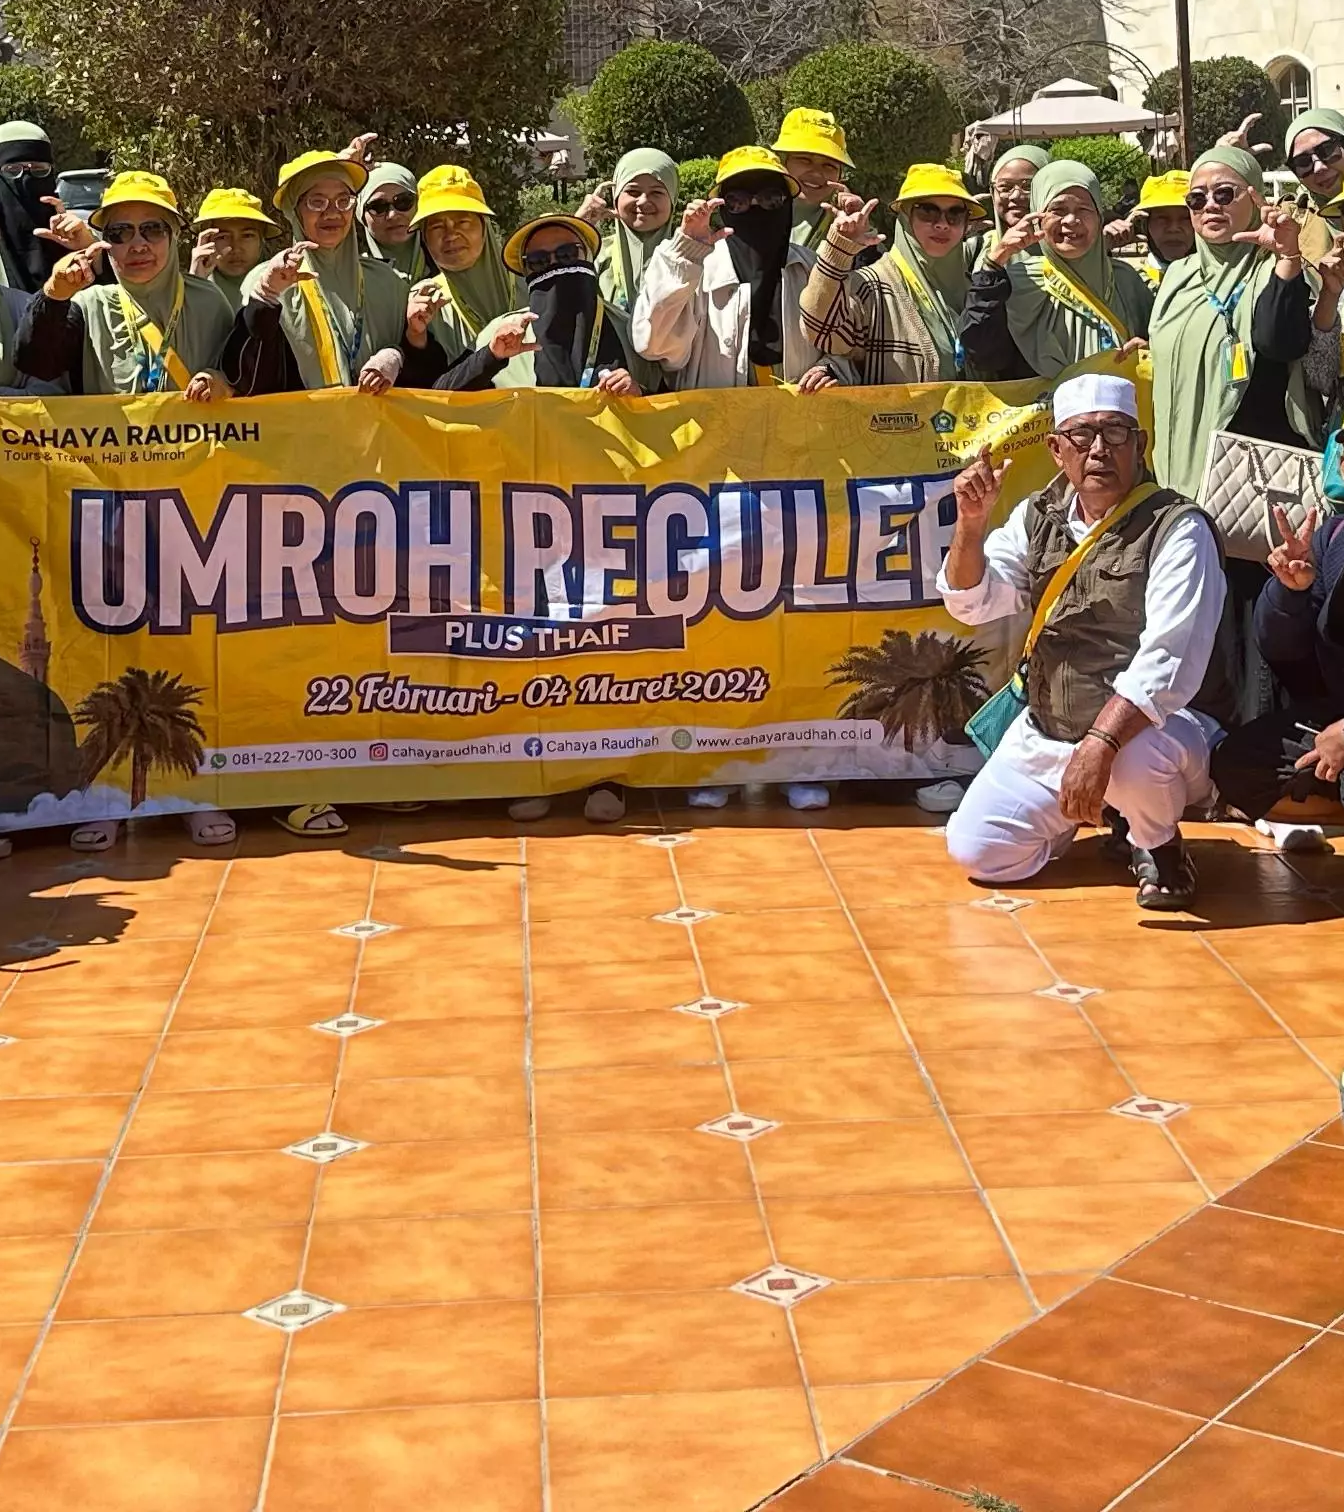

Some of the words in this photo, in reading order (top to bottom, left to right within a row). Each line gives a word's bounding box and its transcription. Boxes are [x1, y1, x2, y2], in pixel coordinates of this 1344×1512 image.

[1, 426, 120, 449] CAHAYA
[126, 421, 260, 446] RAUDHAH
[934, 440, 960, 453] IZIN
[1022, 420, 1043, 433] 817
[4, 449, 41, 461] Tours
[43, 451, 53, 462] &
[56, 452, 99, 466] Travel,
[102, 451, 127, 466] Haji
[130, 450, 139, 463] &
[142, 449, 186, 462] Umroh
[936, 456, 961, 469] IZIN
[72, 482, 477, 632] UMROH
[444, 620, 524, 652] PLUS
[532, 623, 631, 652] THAIF
[307, 676, 350, 714] 22
[358, 671, 498, 715] Februari
[522, 677, 569, 709] 04
[575, 672, 676, 706] Maret
[681, 667, 769, 703] 2024
[546, 738, 598, 754] Cahaya
[601, 735, 660, 751] Raudhah
[696, 728, 873, 747] www.cahayaraudhah.co.id
[231, 747, 357, 766] 081-222-700-300
[391, 742, 512, 760] cahayaraudhah.id
